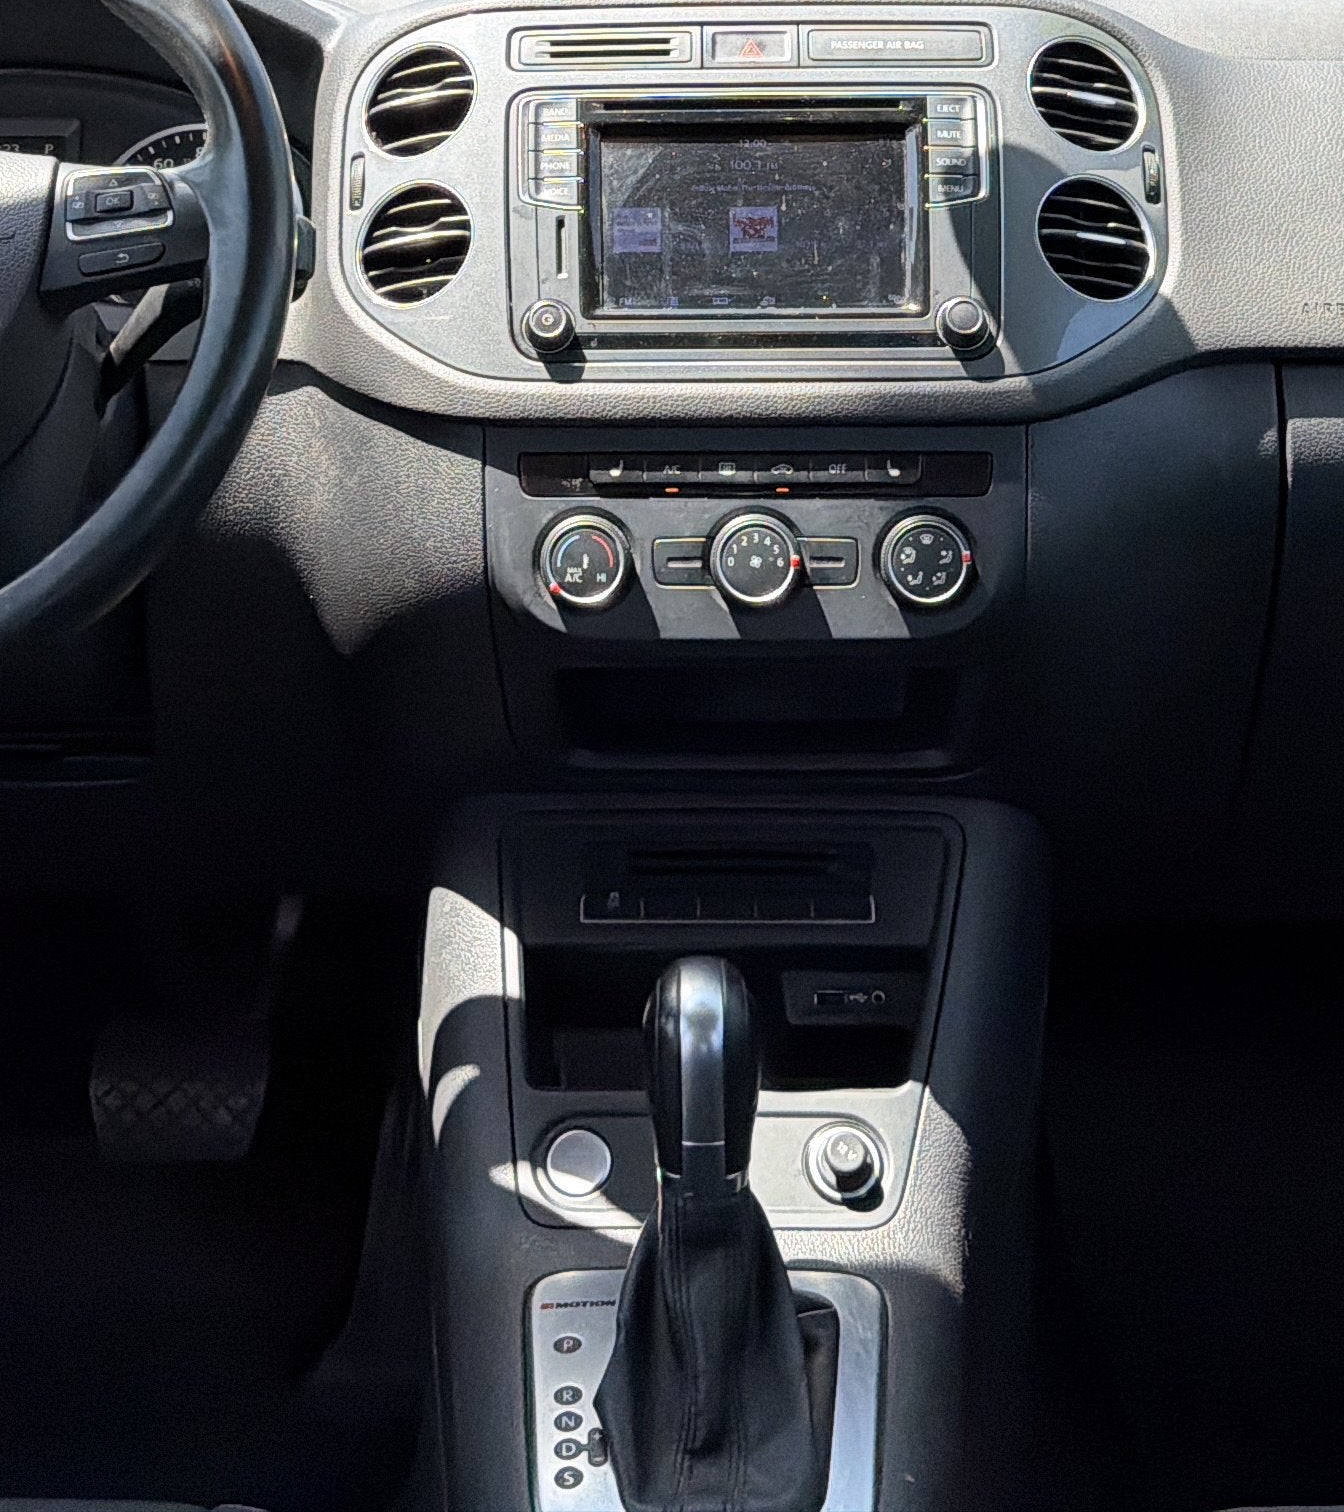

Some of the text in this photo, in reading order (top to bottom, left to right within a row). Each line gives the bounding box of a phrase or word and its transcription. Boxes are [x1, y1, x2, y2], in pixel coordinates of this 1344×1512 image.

[830, 40, 925, 50] PASSENGER AIR BAG
[936, 104, 960, 113] EJECT
[541, 134, 570, 142] MEDIA
[937, 130, 961, 139] MUTE
[154, 159, 174, 170] 60
[540, 161, 570, 170] PHONE
[936, 157, 967, 167] SOUND
[937, 184, 964, 193] MENU
[105, 196, 121, 207] OK
[663, 464, 682, 475] A/C
[828, 463, 848, 474] OFF
[727, 556, 735, 567] 0
[776, 557, 785, 567] 6
[564, 573, 583, 583] A/C
[596, 572, 607, 583] HI
[561, 1415, 576, 1428] N
[562, 1442, 577, 1457] D
[563, 1470, 575, 1486] S
